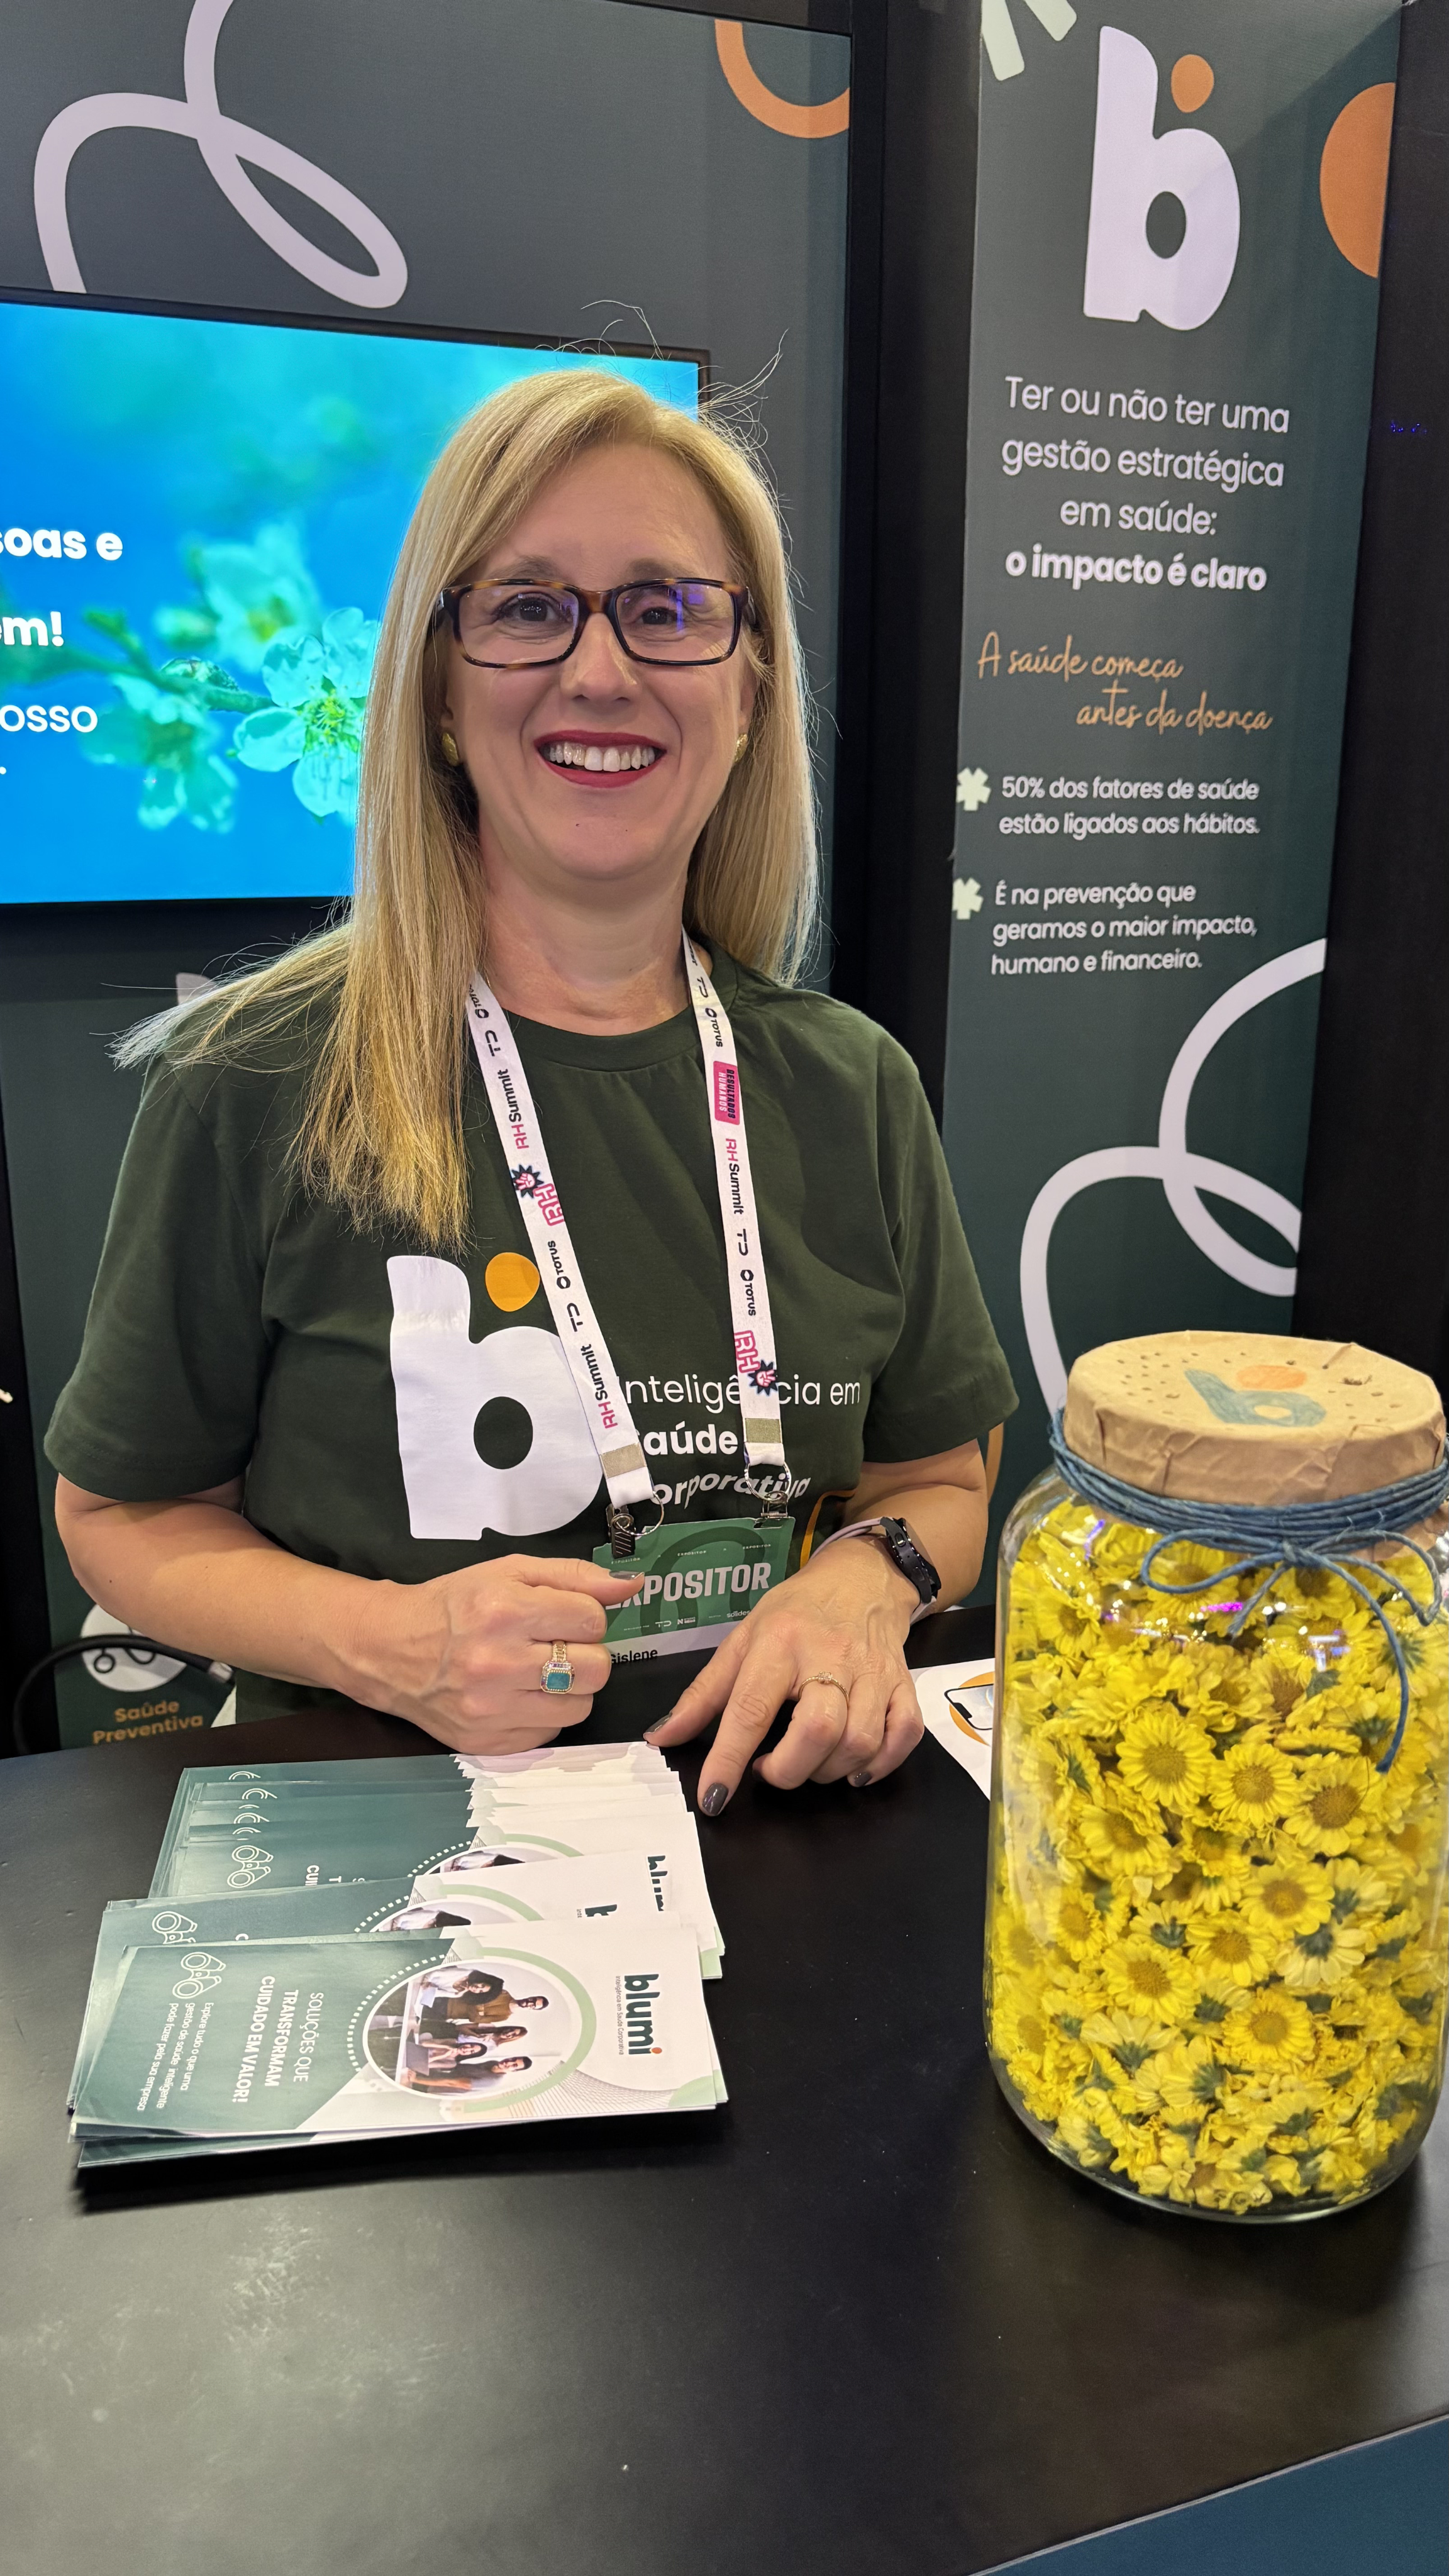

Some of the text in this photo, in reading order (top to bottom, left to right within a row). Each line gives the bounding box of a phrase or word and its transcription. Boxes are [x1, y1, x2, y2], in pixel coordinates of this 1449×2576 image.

[1006, 376, 1289, 433] Ter ou não ter uma
[1002, 440, 1284, 493] gestão estratégica
[1060, 496, 1217, 535] em saúde:
[96, 532, 123, 560] e
[1005, 543, 1267, 591] o impacto é claro
[0, 611, 64, 647] m!
[978, 631, 1184, 683] A saúde começa
[1076, 679, 1274, 735] antes da doença
[1001, 776, 1259, 801] 50% dos fatores de saúde
[999, 813, 1260, 841] estão ligados aos hábitos.
[995, 880, 1197, 911] É na prevenção que
[992, 914, 1258, 947] geramos o maior impacto,
[991, 951, 1202, 975] humano e financeiro.
[718, 1072, 727, 1112] HUMANOS
[726, 1069, 736, 1119] RESULTADOS
[617, 1374, 860, 1413] nteligêcia em
[636, 1421, 738, 1455] aúde
[648, 1472, 811, 1509] orporativa
[114, 1701, 180, 1723] Saúde
[93, 1716, 203, 1744] Preventiva
[167, 2003, 179, 2022] pode
[198, 2002, 213, 2028] Explore
[625, 1974, 662, 2055] blumi
[160, 2024, 173, 2041] fazer
[192, 2030, 207, 2047] tudo
[233, 1976, 275, 2102] CUIDADO EM VALOR!
[265, 1990, 298, 2086] TRANSFORMAM
[294, 1993, 323, 2082] SOLUÇÕES QUE
[149, 2062, 160, 2075] sua
[156, 2003, 195, 2108] gestão de saúde inteligente
[184, 2056, 197, 2070] que
[137, 2077, 156, 2111] empresa
[180, 2072, 192, 2090] uma
